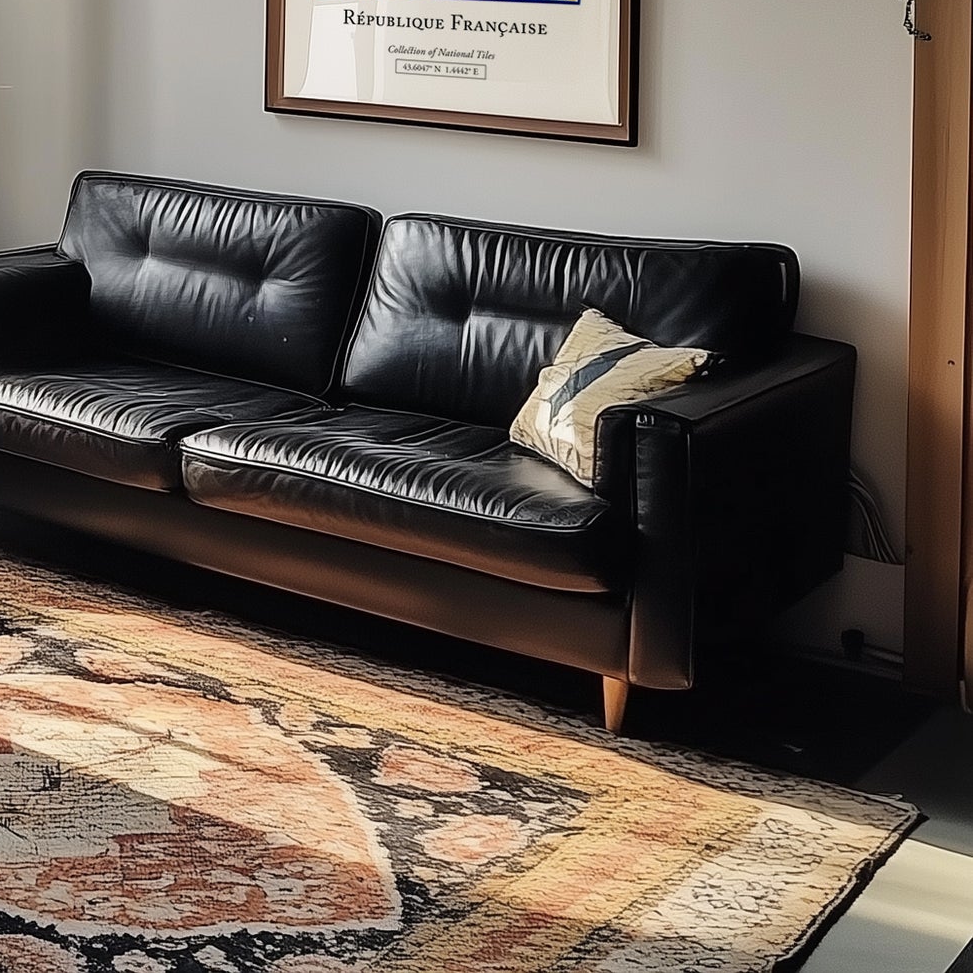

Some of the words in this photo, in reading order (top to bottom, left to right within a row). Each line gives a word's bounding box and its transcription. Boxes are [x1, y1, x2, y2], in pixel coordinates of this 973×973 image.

[387, 44, 426, 56] Collection
[427, 47, 438, 59] of
[438, 48, 474, 59] National
[476, 50, 495, 60] Tiles
[434, 65, 441, 73] N
[473, 67, 480, 76] E
